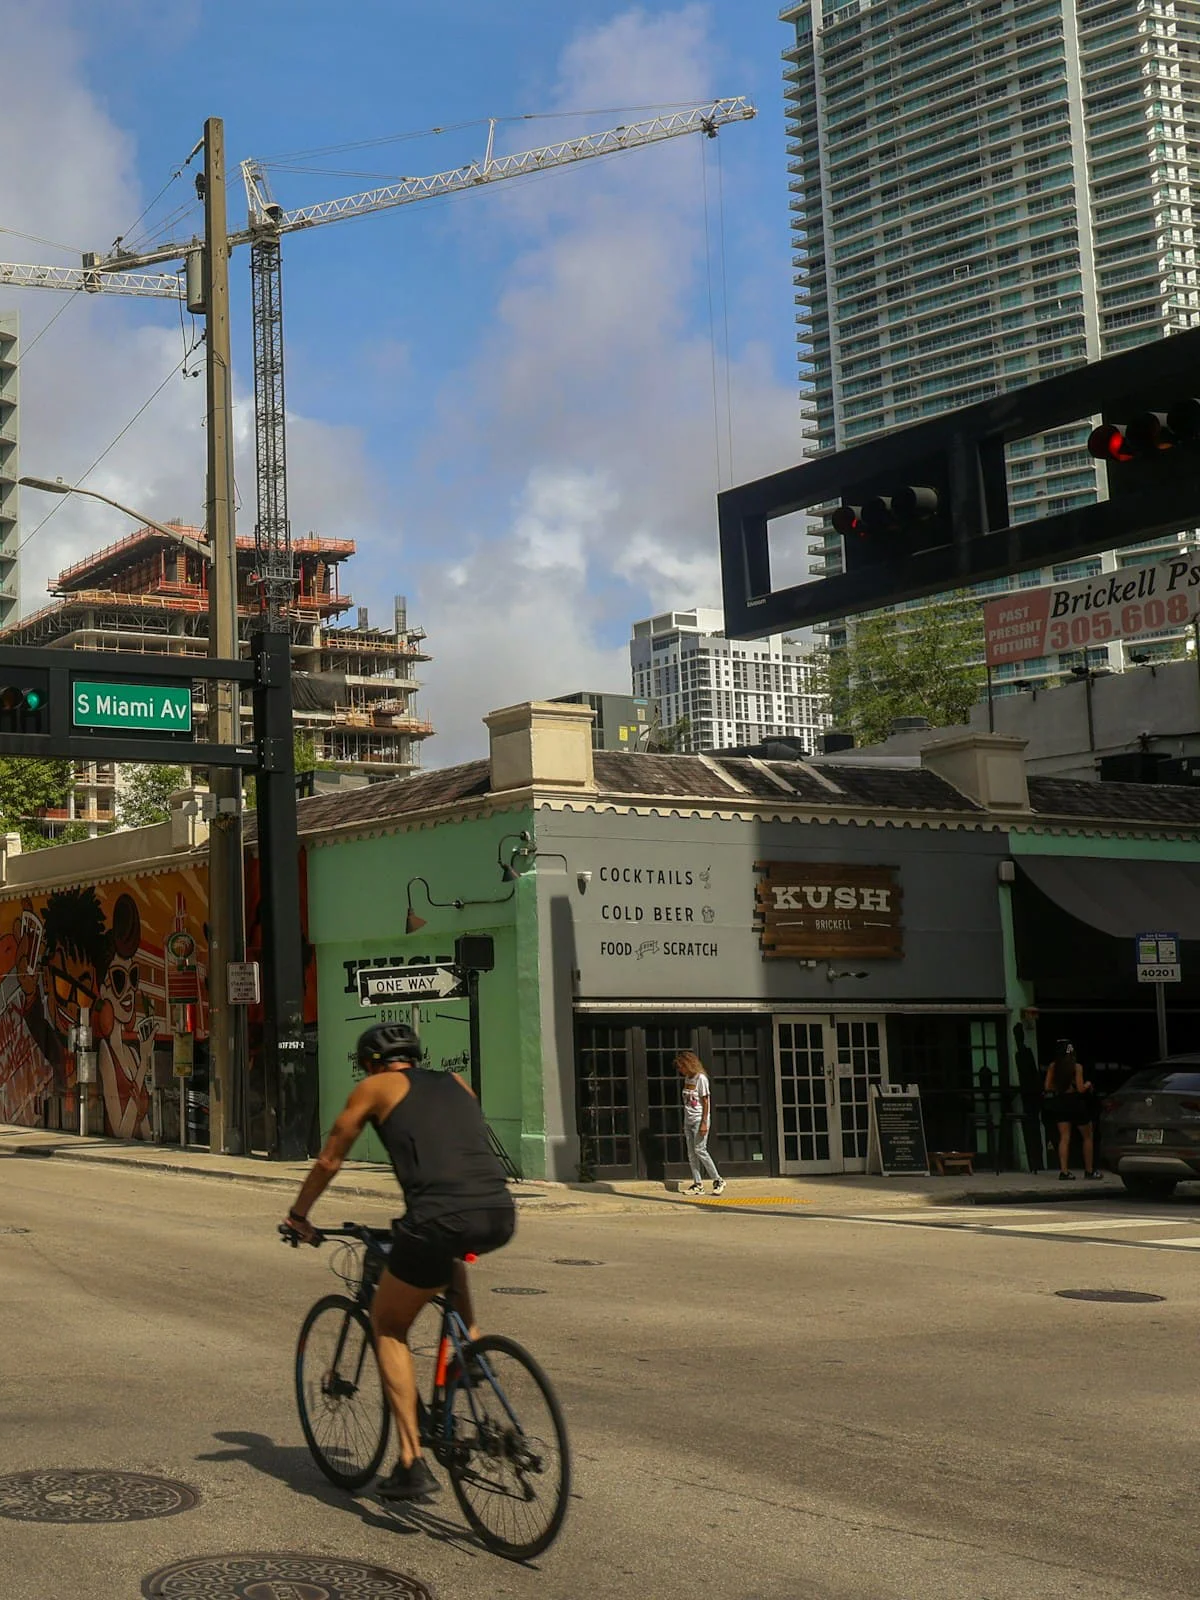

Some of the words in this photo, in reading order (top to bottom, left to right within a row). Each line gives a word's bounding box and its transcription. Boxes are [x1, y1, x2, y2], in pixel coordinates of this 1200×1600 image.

[1051, 567, 1157, 618] Brickell
[999, 606, 1031, 623] PAST
[988, 619, 1043, 642] PRESENT
[993, 636, 1040, 656] FUTURE
[77, 694, 90, 714] S
[96, 695, 154, 718] Miami
[160, 699, 187, 719] Av
[600, 866, 693, 885] COCKTAILS
[771, 886, 891, 912] KUSH
[602, 905, 644, 920] COLD
[654, 907, 694, 921] BEER
[815, 919, 853, 930] BRICKELL
[600, 942, 632, 956] FOOD
[663, 942, 718, 957] SCRATCH
[1141, 969, 1175, 977] 40201
[376, 979, 405, 992] ONE
[408, 977, 436, 990] WAY
[381, 1009, 431, 1023] BRICKLL
